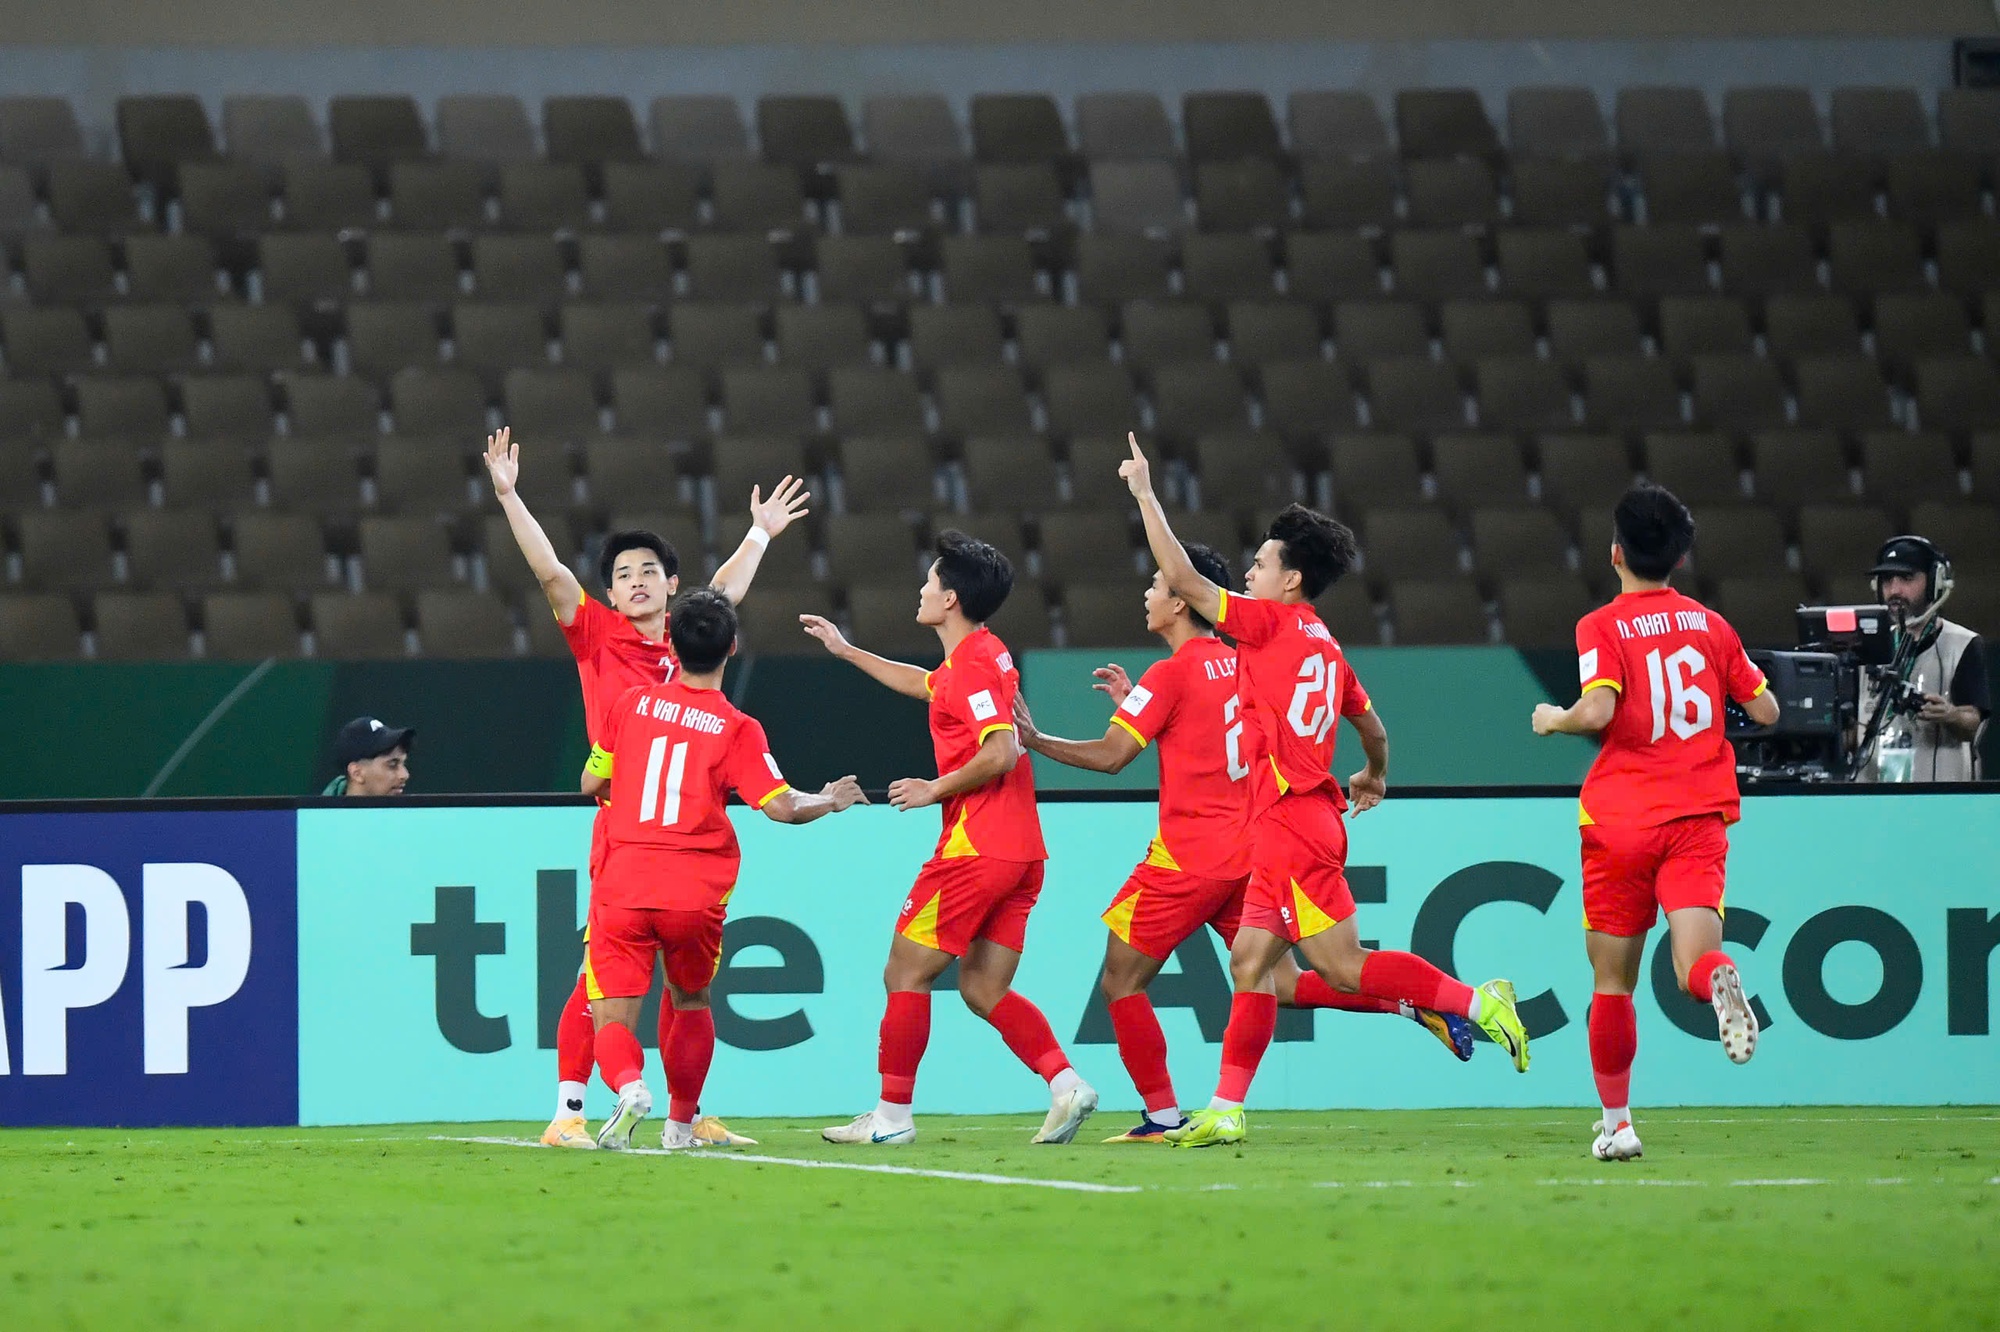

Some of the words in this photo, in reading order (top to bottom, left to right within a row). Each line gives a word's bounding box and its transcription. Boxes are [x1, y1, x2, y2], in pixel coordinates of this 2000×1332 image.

[1632, 612, 1671, 637] NHAT
[636, 695, 650, 716] K.
[652, 698, 681, 723] VAN
[680, 706, 726, 735] KHANG
[1287, 652, 1336, 745] 21
[1645, 644, 1713, 744] 16
[639, 735, 688, 827] 11
[0, 862, 252, 1075] PP
